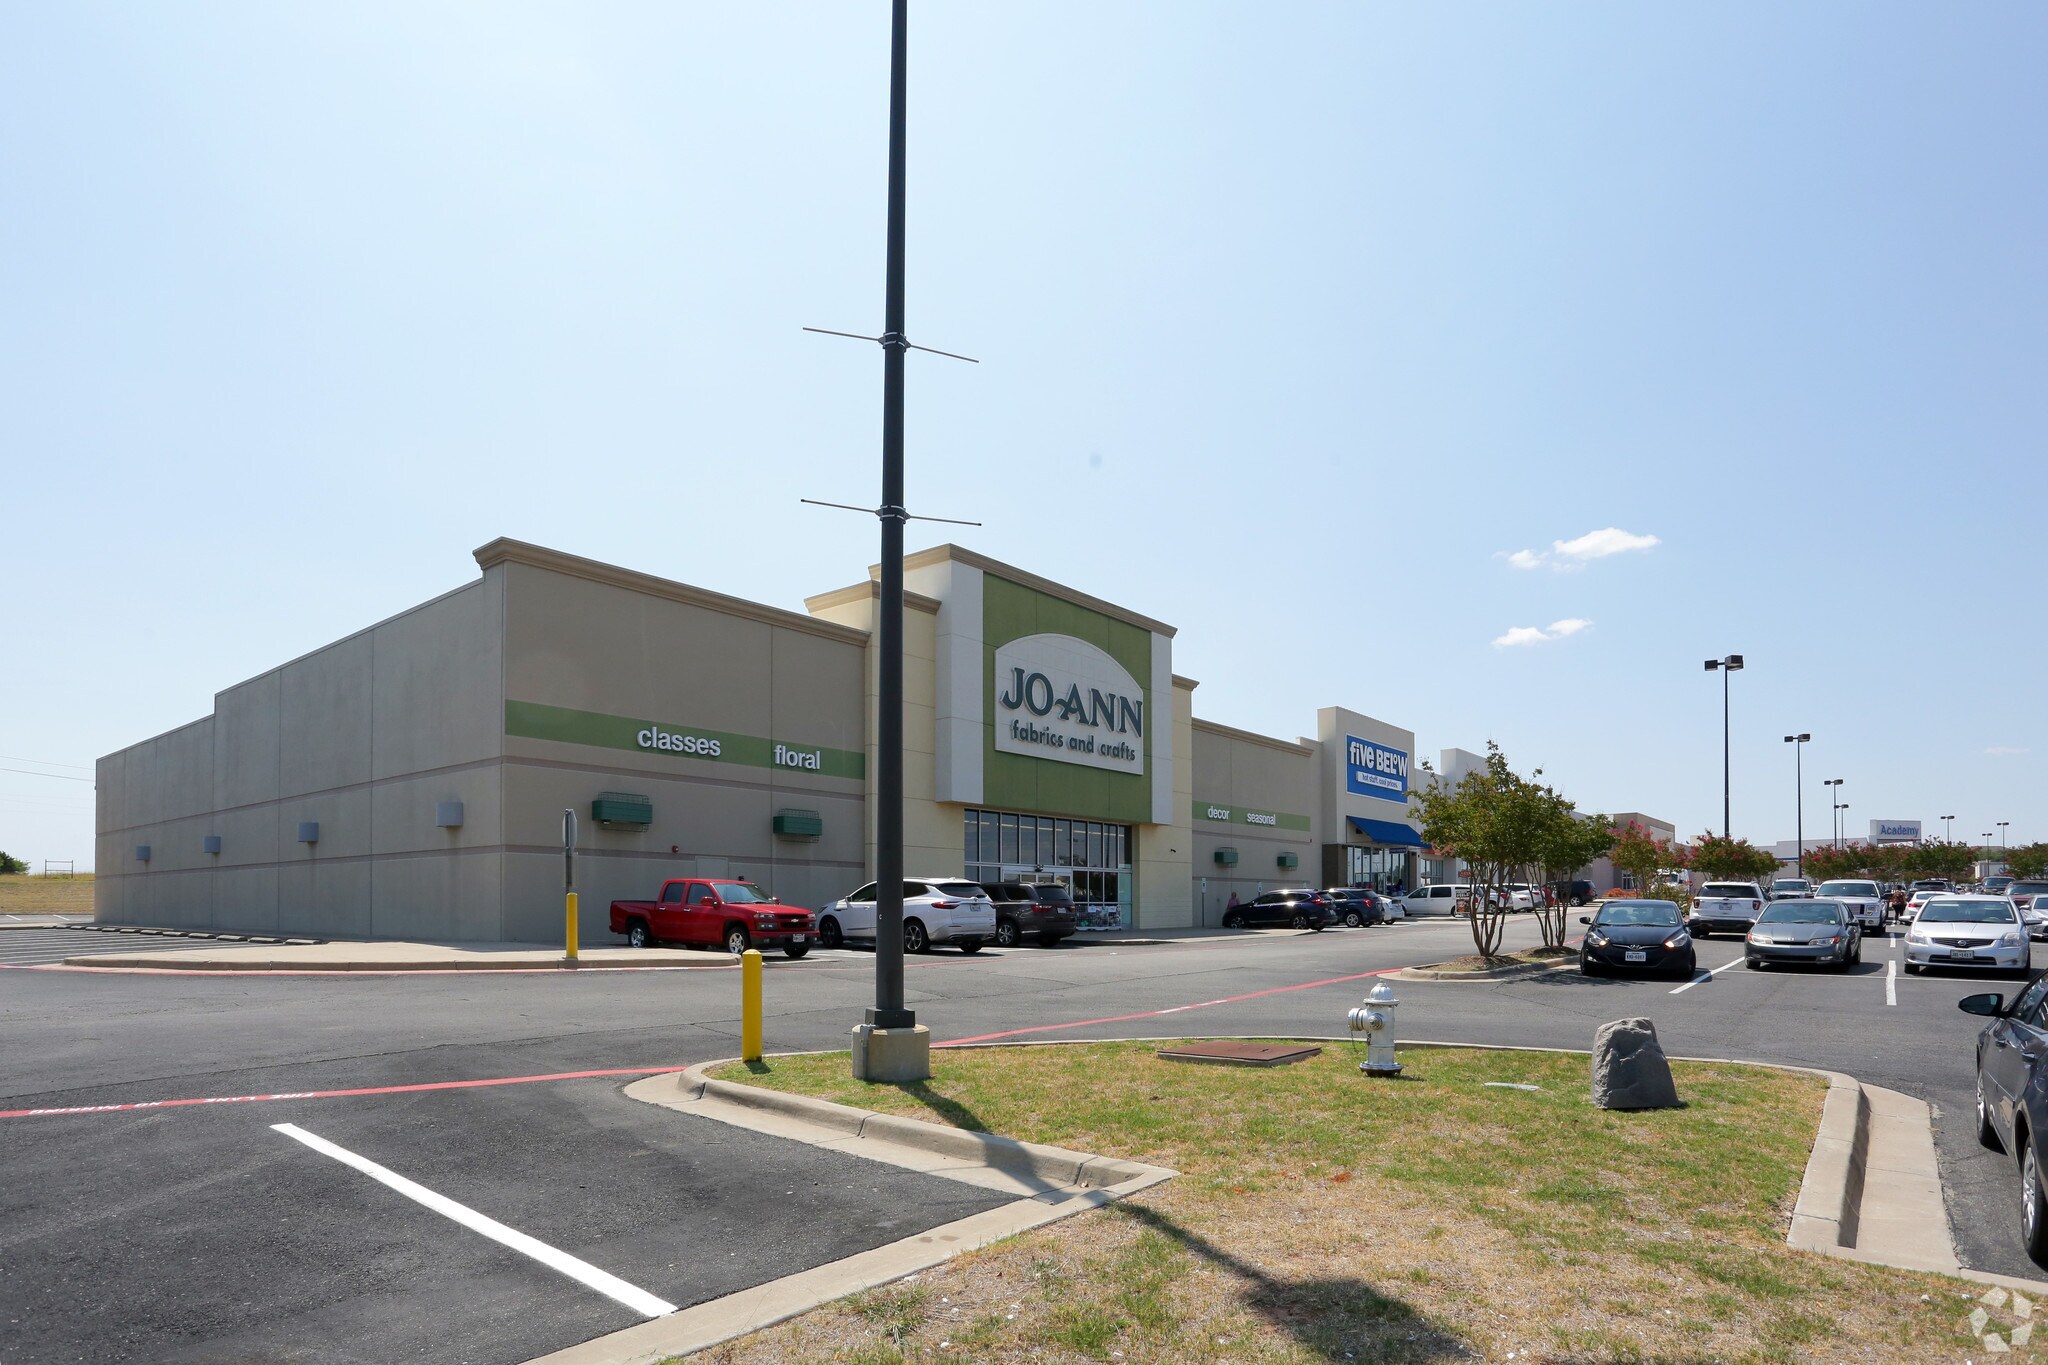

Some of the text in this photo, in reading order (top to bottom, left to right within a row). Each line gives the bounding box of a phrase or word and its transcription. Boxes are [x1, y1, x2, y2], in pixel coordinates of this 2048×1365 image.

[636, 726, 721, 757] classes
[1011, 719, 1136, 761] fabrics and crafts
[773, 744, 821, 770] floral
[1208, 806, 1230, 820] decor
[1247, 813, 1276, 826] seasonal
[1880, 824, 1919, 838] Academy
